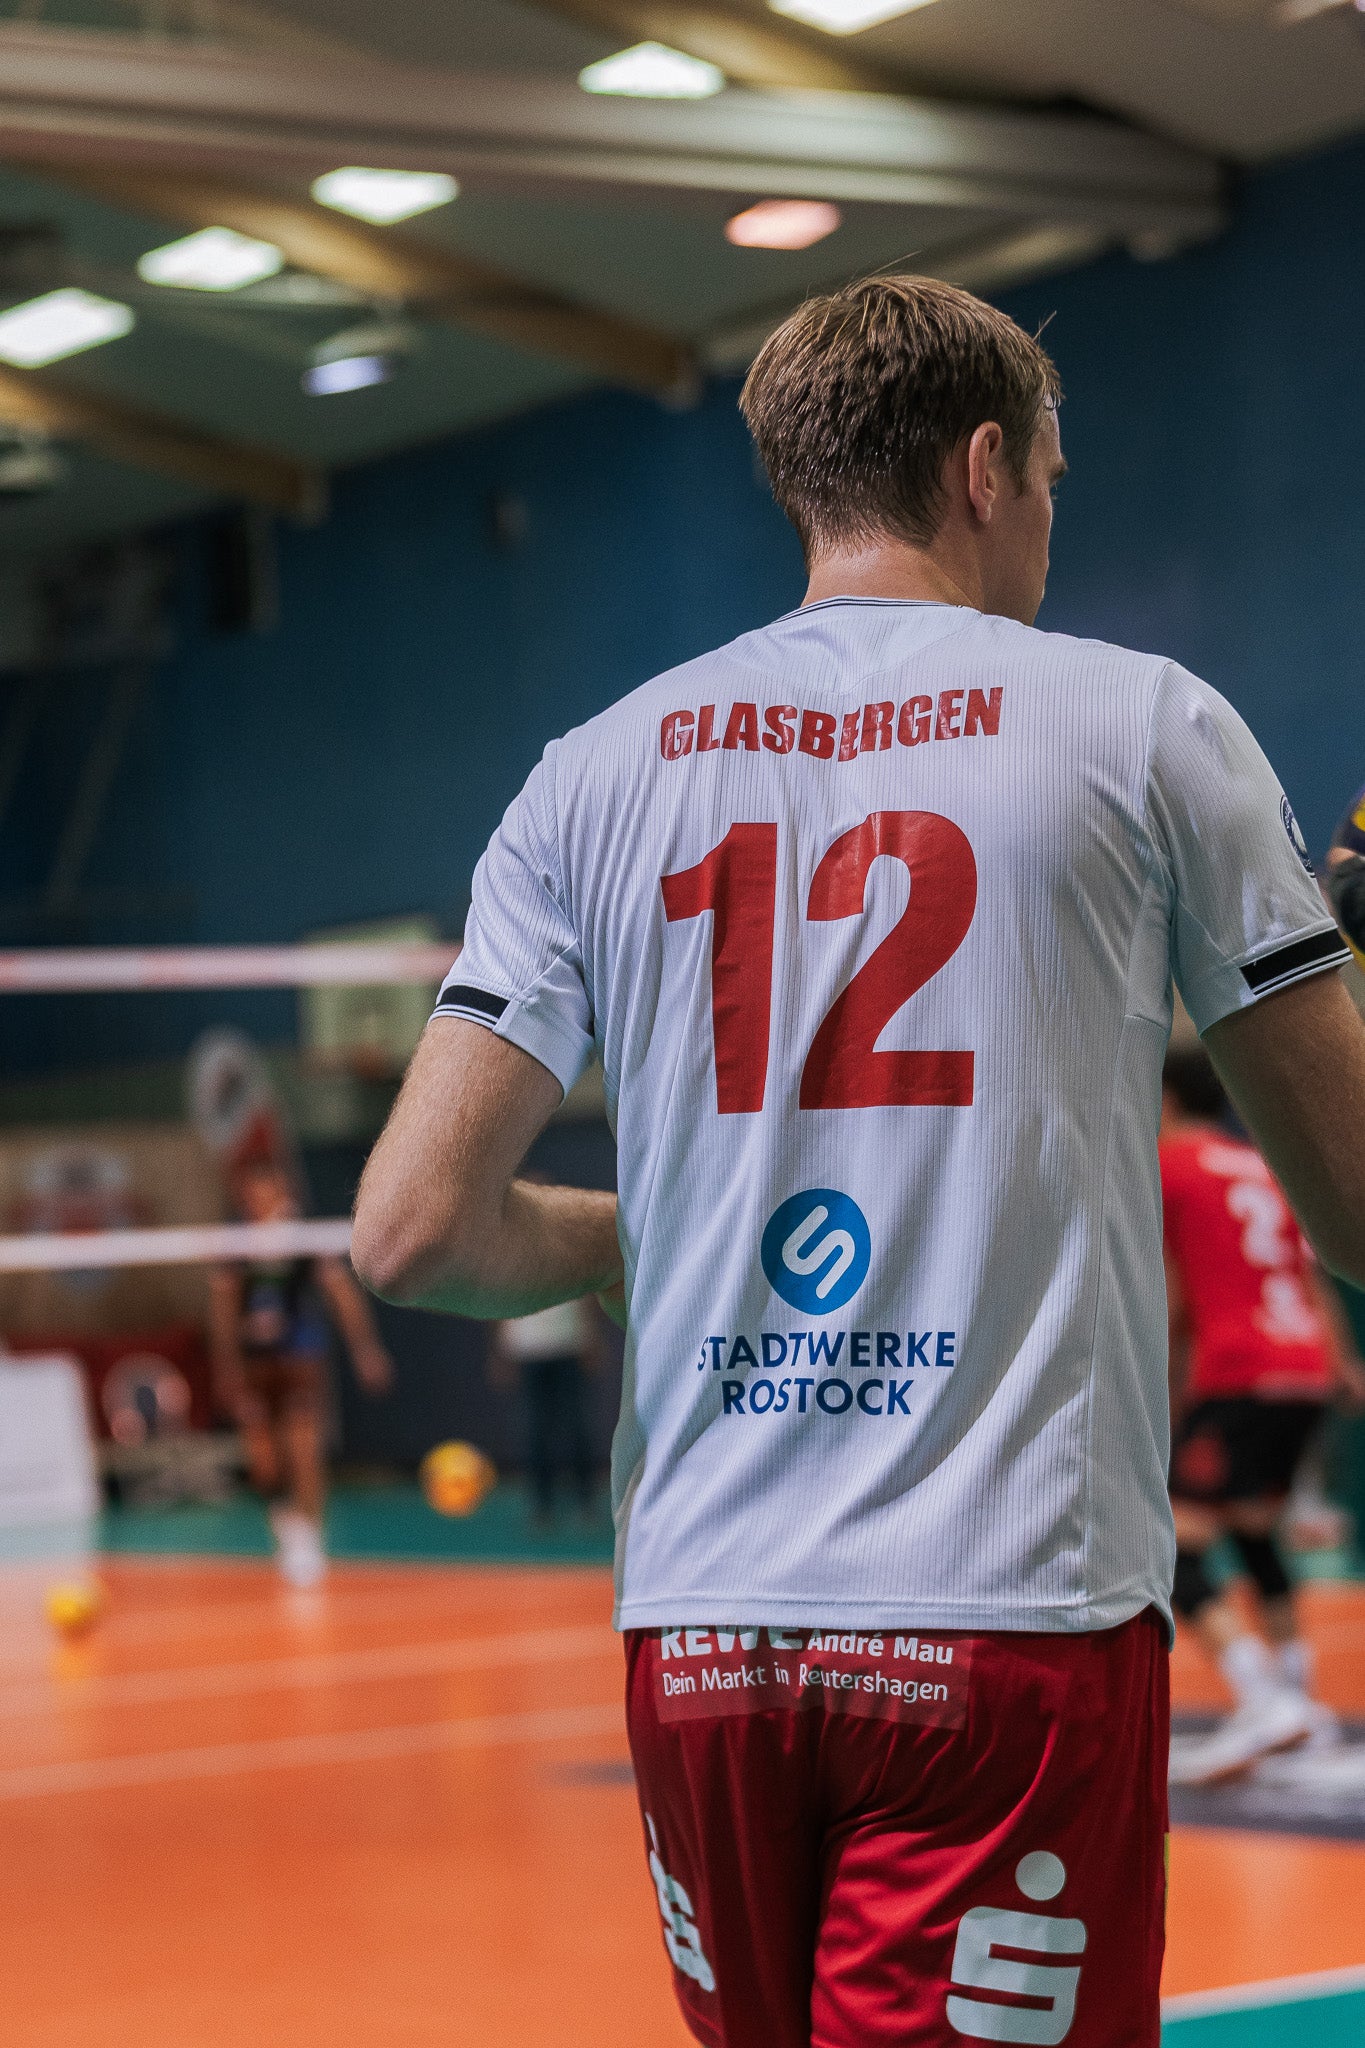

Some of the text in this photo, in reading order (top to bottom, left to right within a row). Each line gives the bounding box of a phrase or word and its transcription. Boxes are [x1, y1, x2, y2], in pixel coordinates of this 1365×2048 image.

[661, 687, 1004, 762] GLASBERGEN
[660, 810, 978, 1114] 12
[697, 1331, 956, 1372] STADTWERKE
[721, 1377, 914, 1416] ROSTOCK
[807, 1628, 884, 1657] André
[893, 1636, 953, 1665] Mau
[662, 1661, 949, 1703] Dein Markt in Reutershagen
